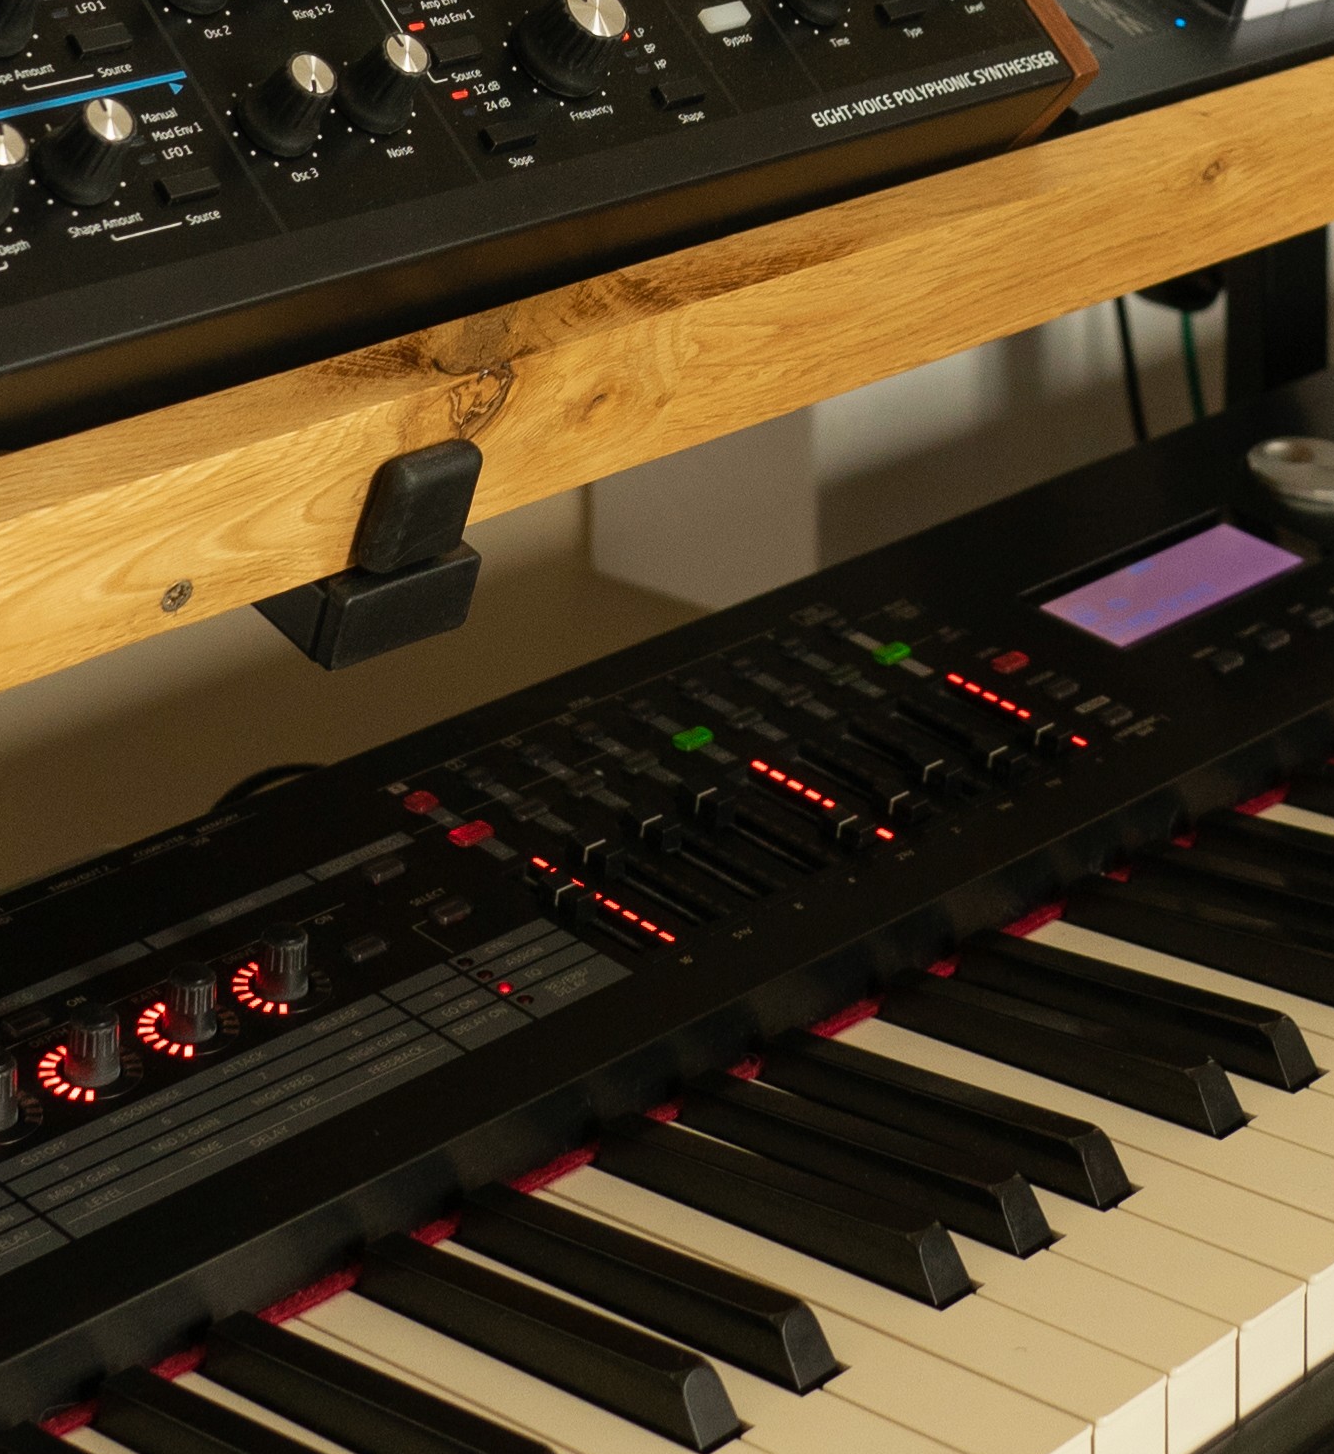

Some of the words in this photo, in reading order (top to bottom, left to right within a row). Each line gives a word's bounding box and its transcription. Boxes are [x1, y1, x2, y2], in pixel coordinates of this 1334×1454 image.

[291, 8, 317, 20] Ring
[722, 33, 753, 48] Bypass
[450, 69, 483, 83] Source
[810, 93, 895, 128] EIGHT-VOICE
[892, 71, 976, 106] POLYPHONIC
[974, 50, 1058, 86] SYNTHESISER
[569, 104, 614, 122] Frequency
[386, 145, 415, 159] Noise
[507, 154, 535, 169] Slope
